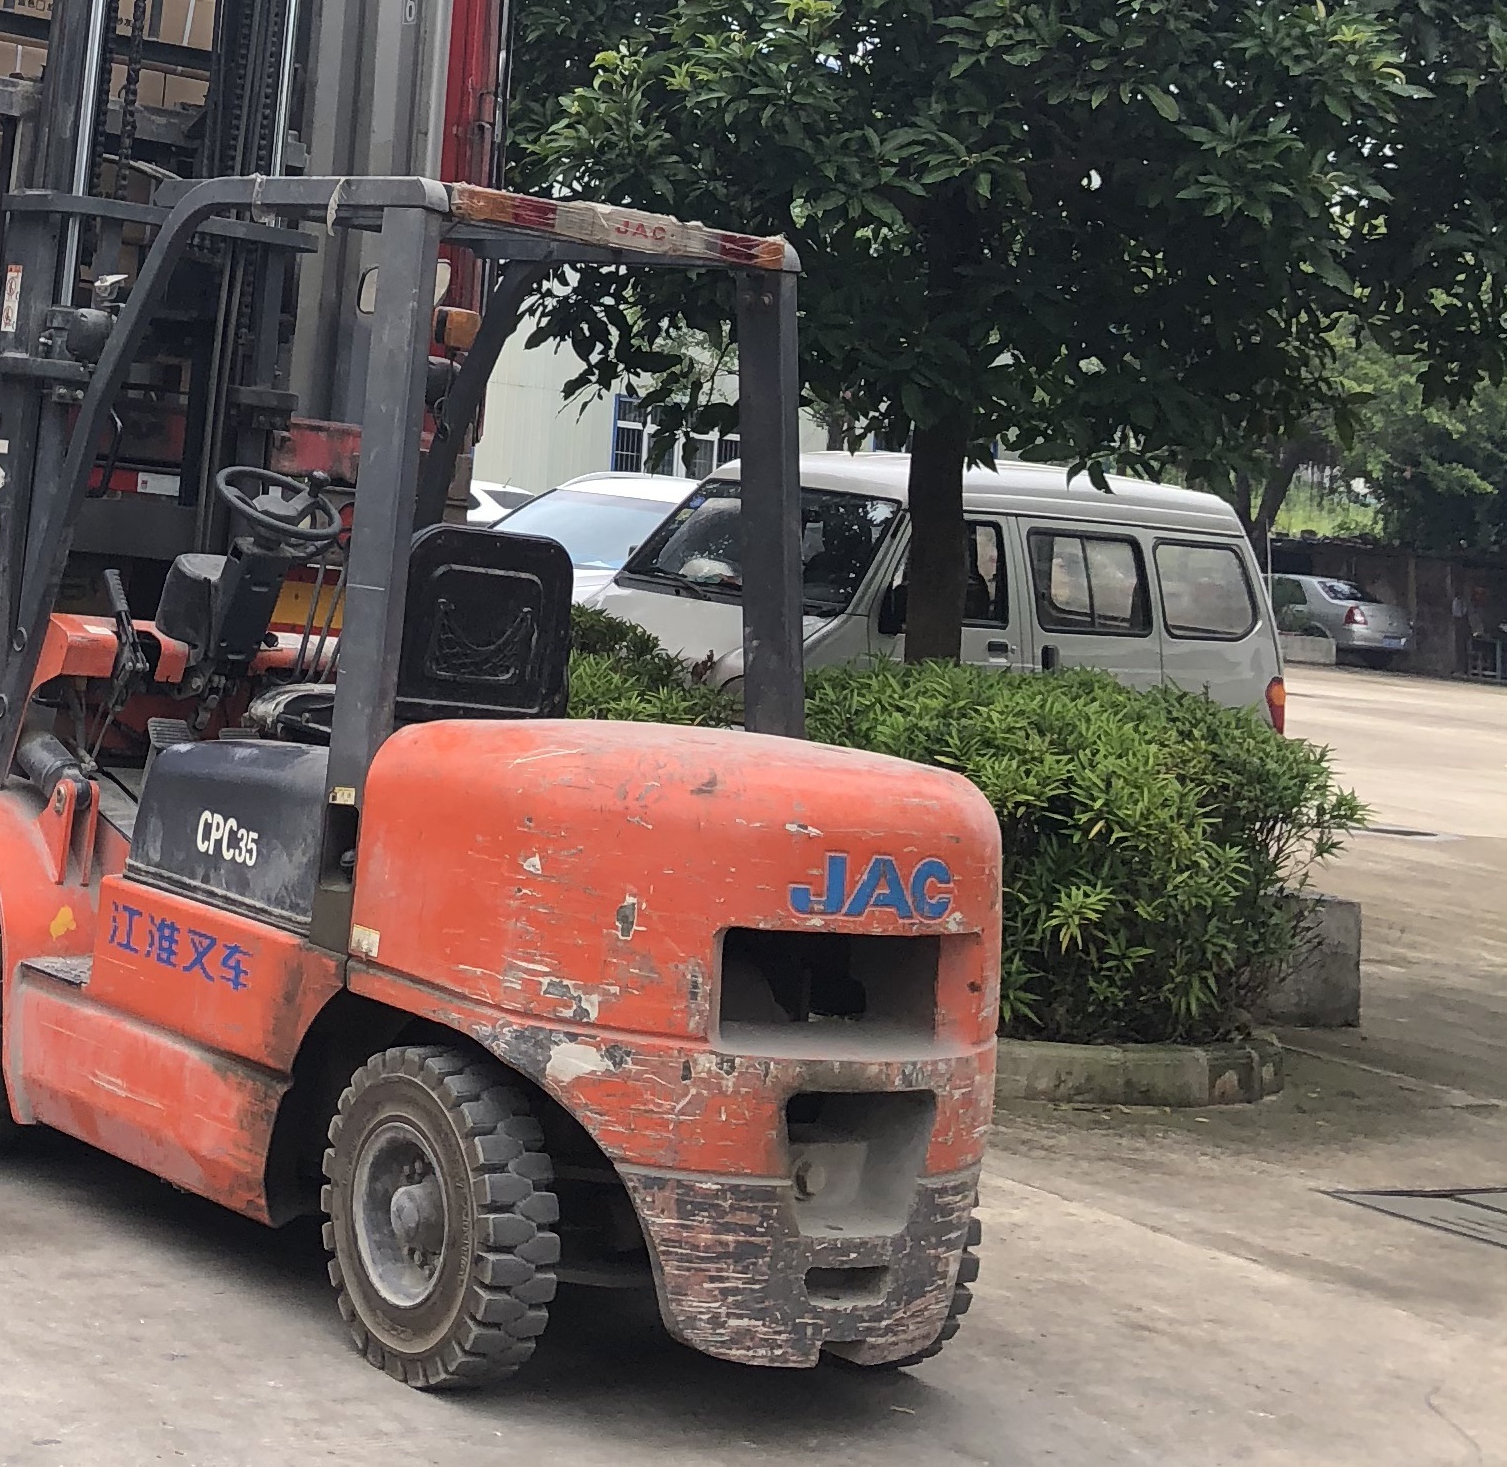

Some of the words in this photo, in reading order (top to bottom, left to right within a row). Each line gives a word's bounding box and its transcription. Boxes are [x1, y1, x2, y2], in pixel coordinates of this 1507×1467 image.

[614, 220, 667, 241] JAC
[196, 809, 259, 867] CPC35
[788, 851, 954, 923] JAC
[108, 900, 254, 991] 江淮叉车
